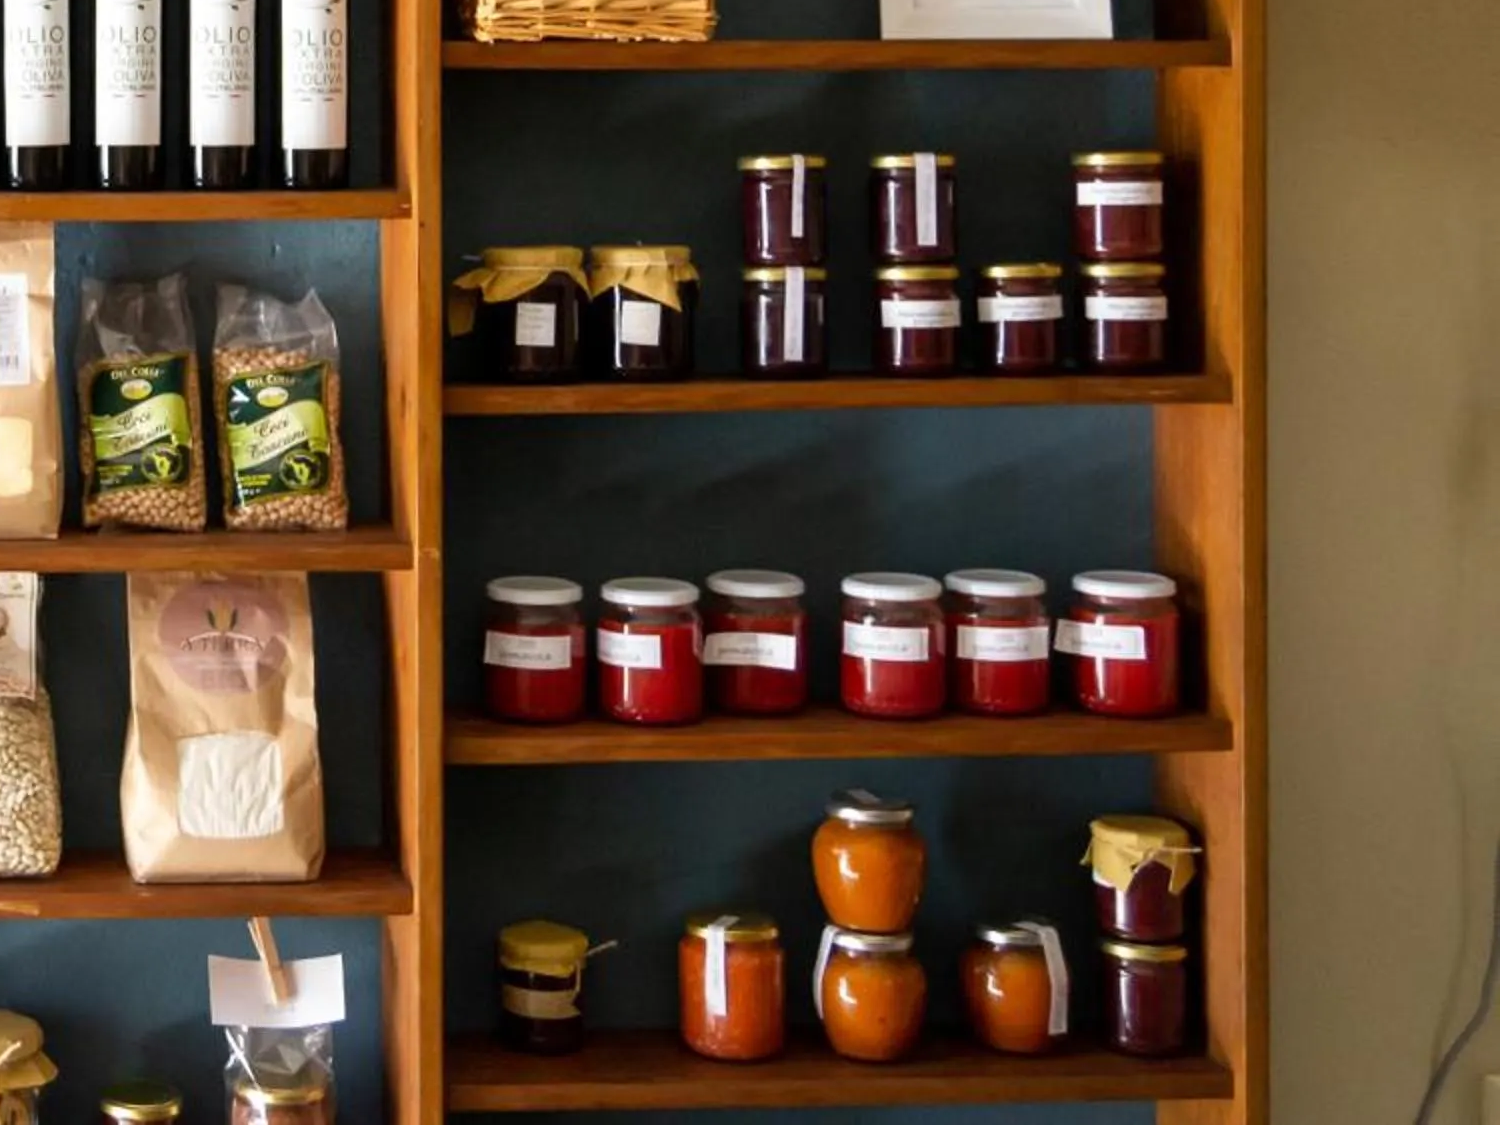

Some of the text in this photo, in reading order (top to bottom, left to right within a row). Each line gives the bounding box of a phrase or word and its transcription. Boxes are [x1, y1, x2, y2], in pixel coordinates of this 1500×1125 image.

[9, 26, 65, 44] OLIO
[101, 26, 157, 44] OLIO
[195, 26, 251, 44] OLIO
[290, 27, 343, 48] OLIO
[18, 45, 65, 58] XTRA
[111, 45, 156, 58] XTRA
[205, 45, 251, 58] XTRA
[299, 47, 343, 60] XTRA
